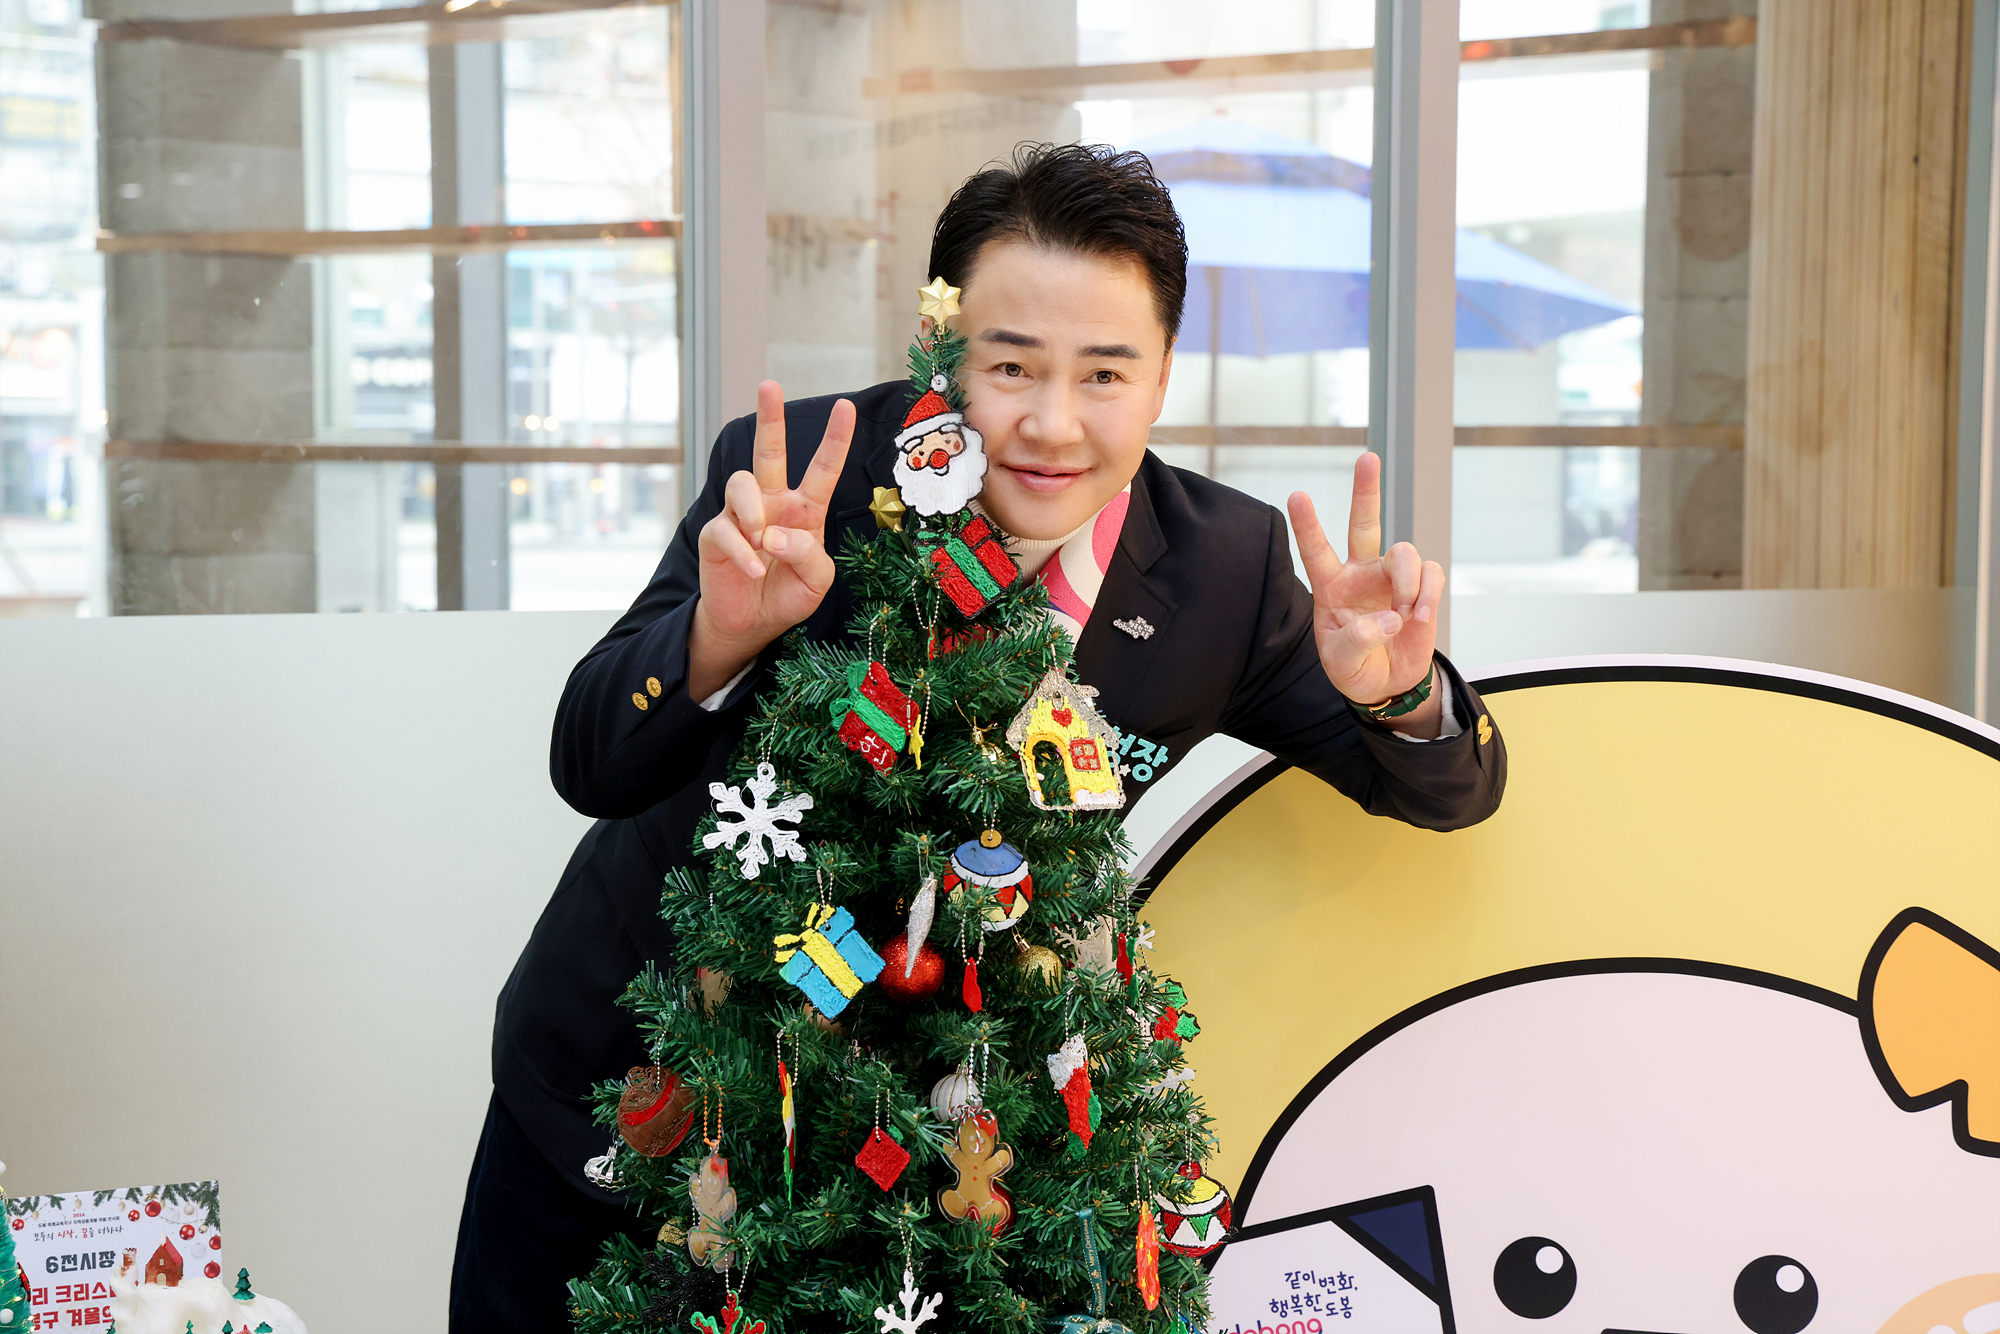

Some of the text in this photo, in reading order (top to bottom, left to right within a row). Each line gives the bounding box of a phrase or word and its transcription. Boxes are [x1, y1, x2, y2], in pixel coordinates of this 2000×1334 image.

[1113, 618, 1139, 639] dobong
[34, 1231, 54, 1242] 모두의
[81, 1226, 95, 1239] 꿈을
[97, 1225, 124, 1235] 더하다
[45, 1250, 116, 1274] 6전시장
[1285, 1270, 1358, 1294] 같이 변화,
[1269, 1292, 1353, 1319] 행복한 도봉
